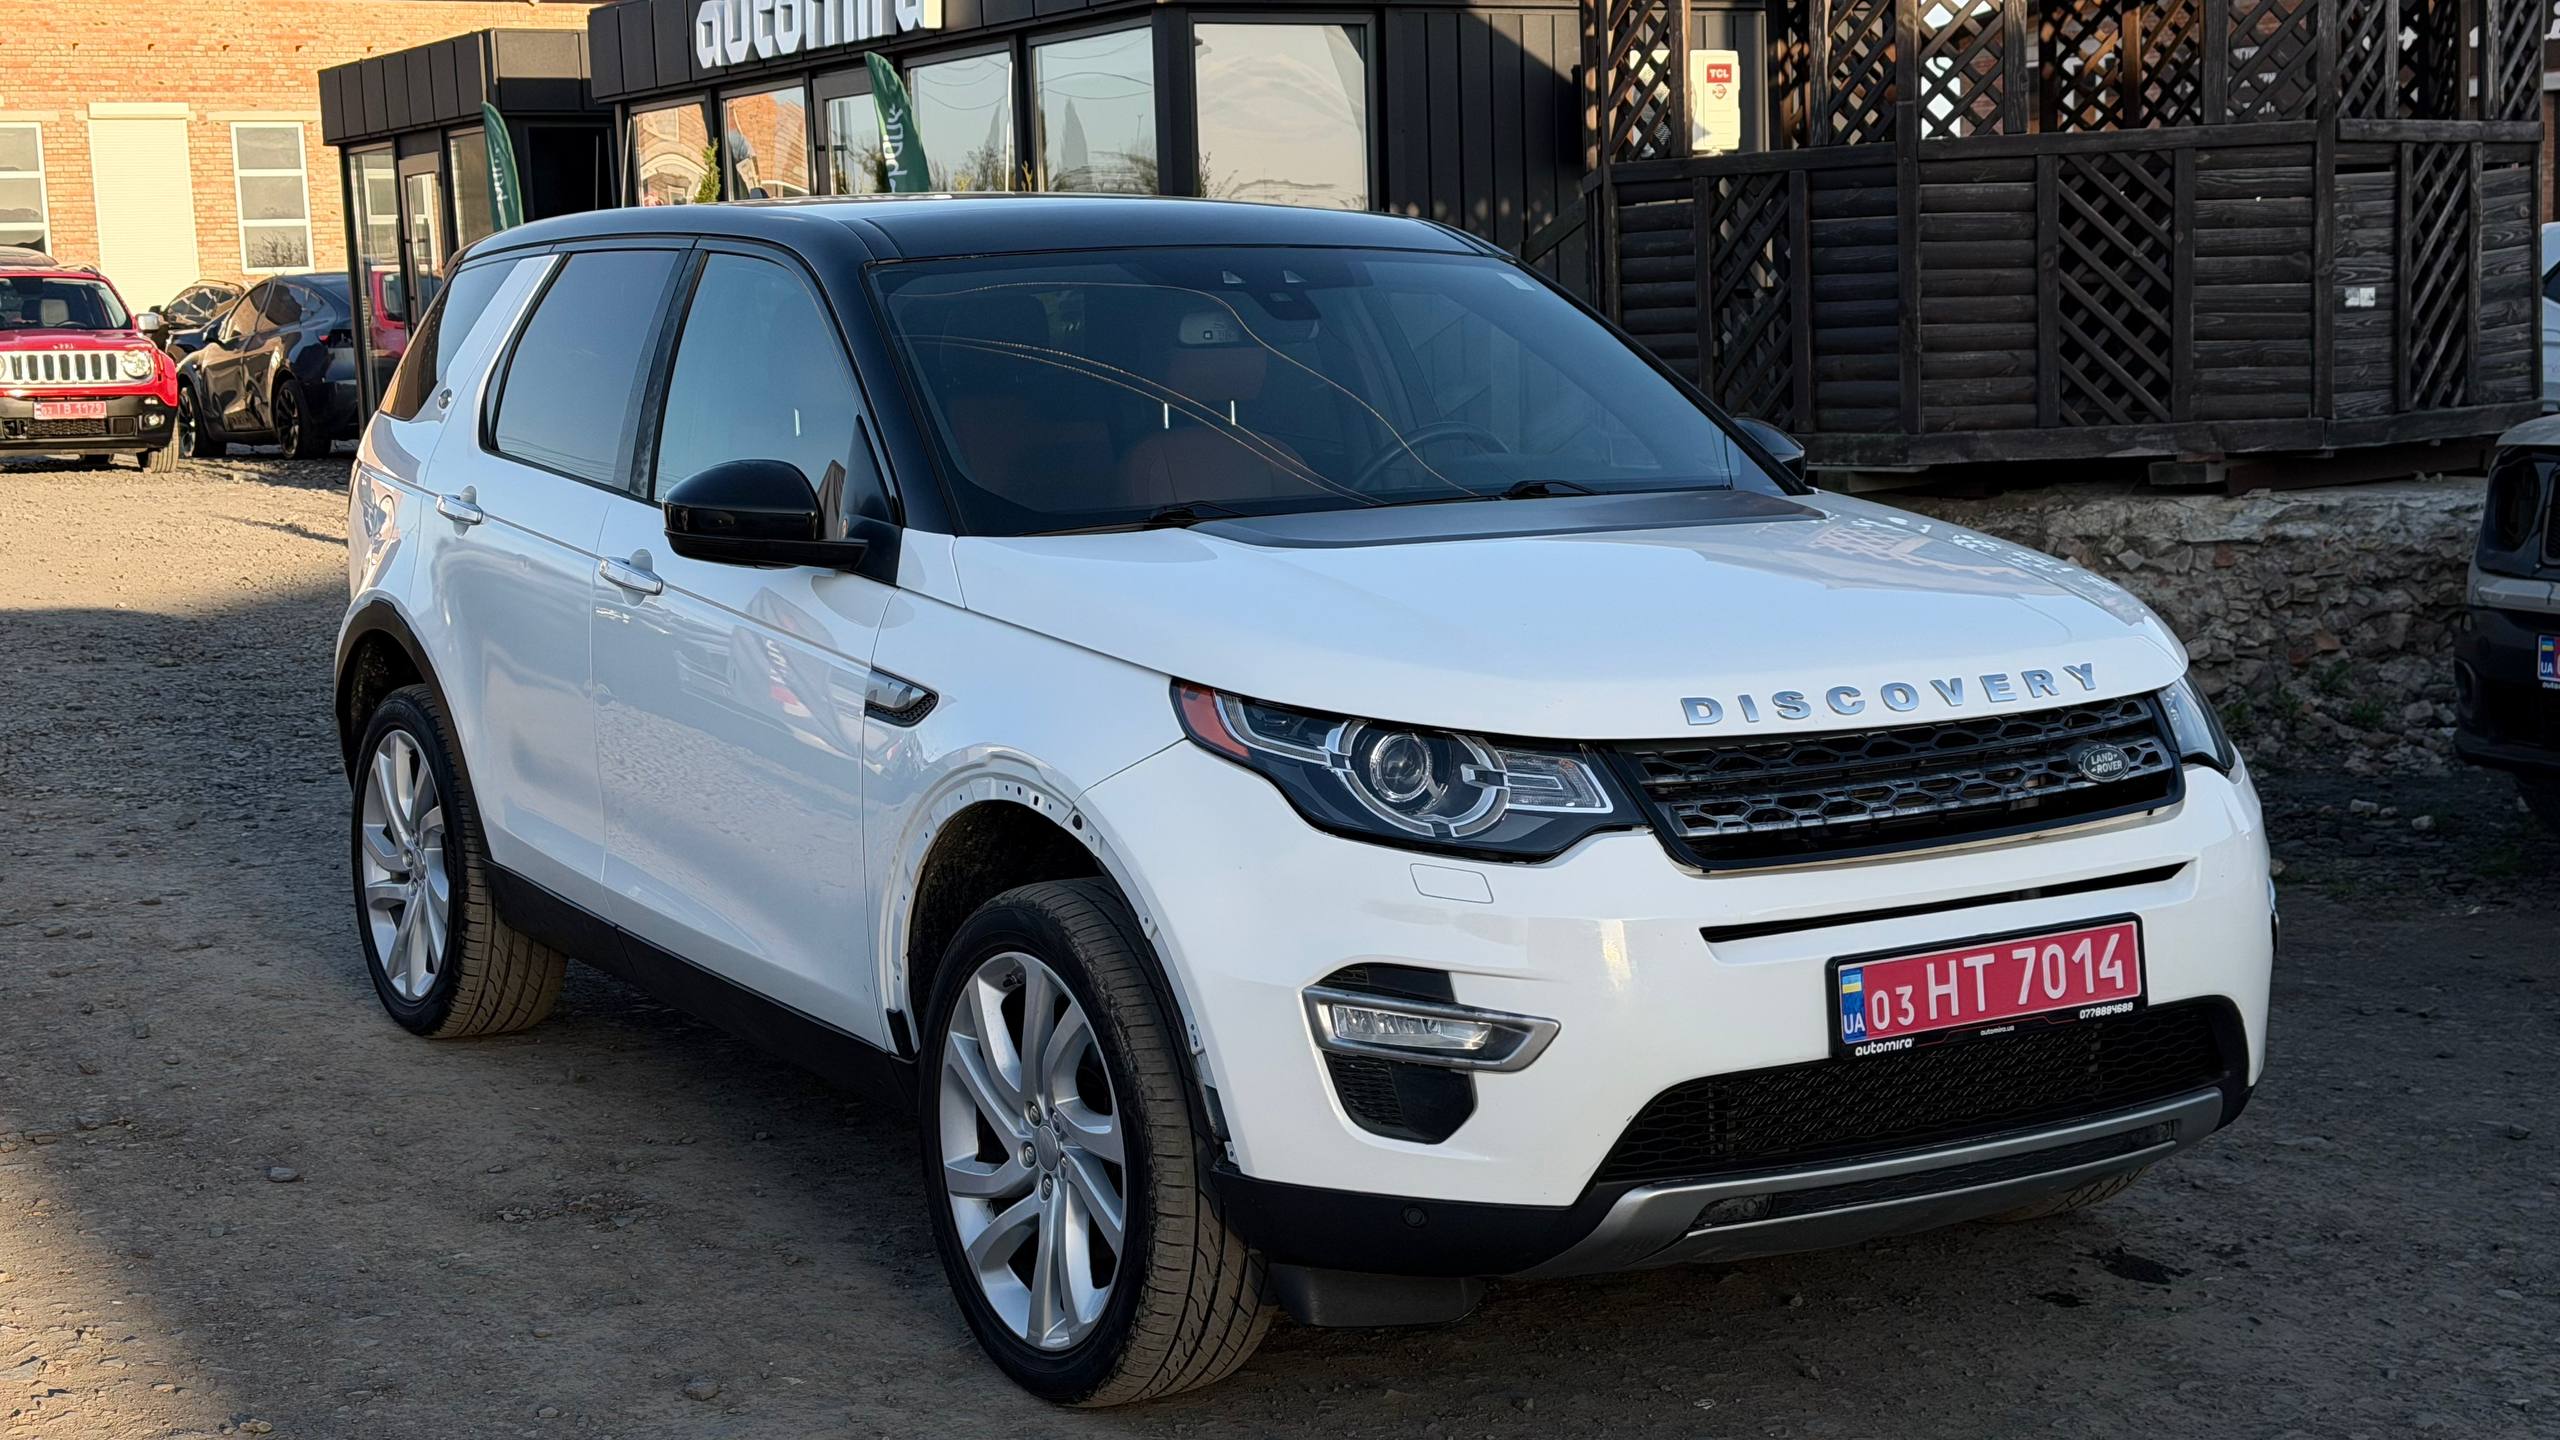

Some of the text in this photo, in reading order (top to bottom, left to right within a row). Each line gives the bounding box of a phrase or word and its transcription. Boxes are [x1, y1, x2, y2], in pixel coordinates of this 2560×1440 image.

[1710, 69, 1729, 78] TCL
[2541, 662, 2553, 673] UA
[1680, 663, 2097, 726] DISCOVERY
[2091, 752, 2114, 765] LAND
[2096, 760, 2123, 774] ROVER
[1871, 933, 2124, 1030] 03 HT 7014
[1844, 1012, 1866, 1034] UA
[1855, 1038, 1913, 1056] automira
